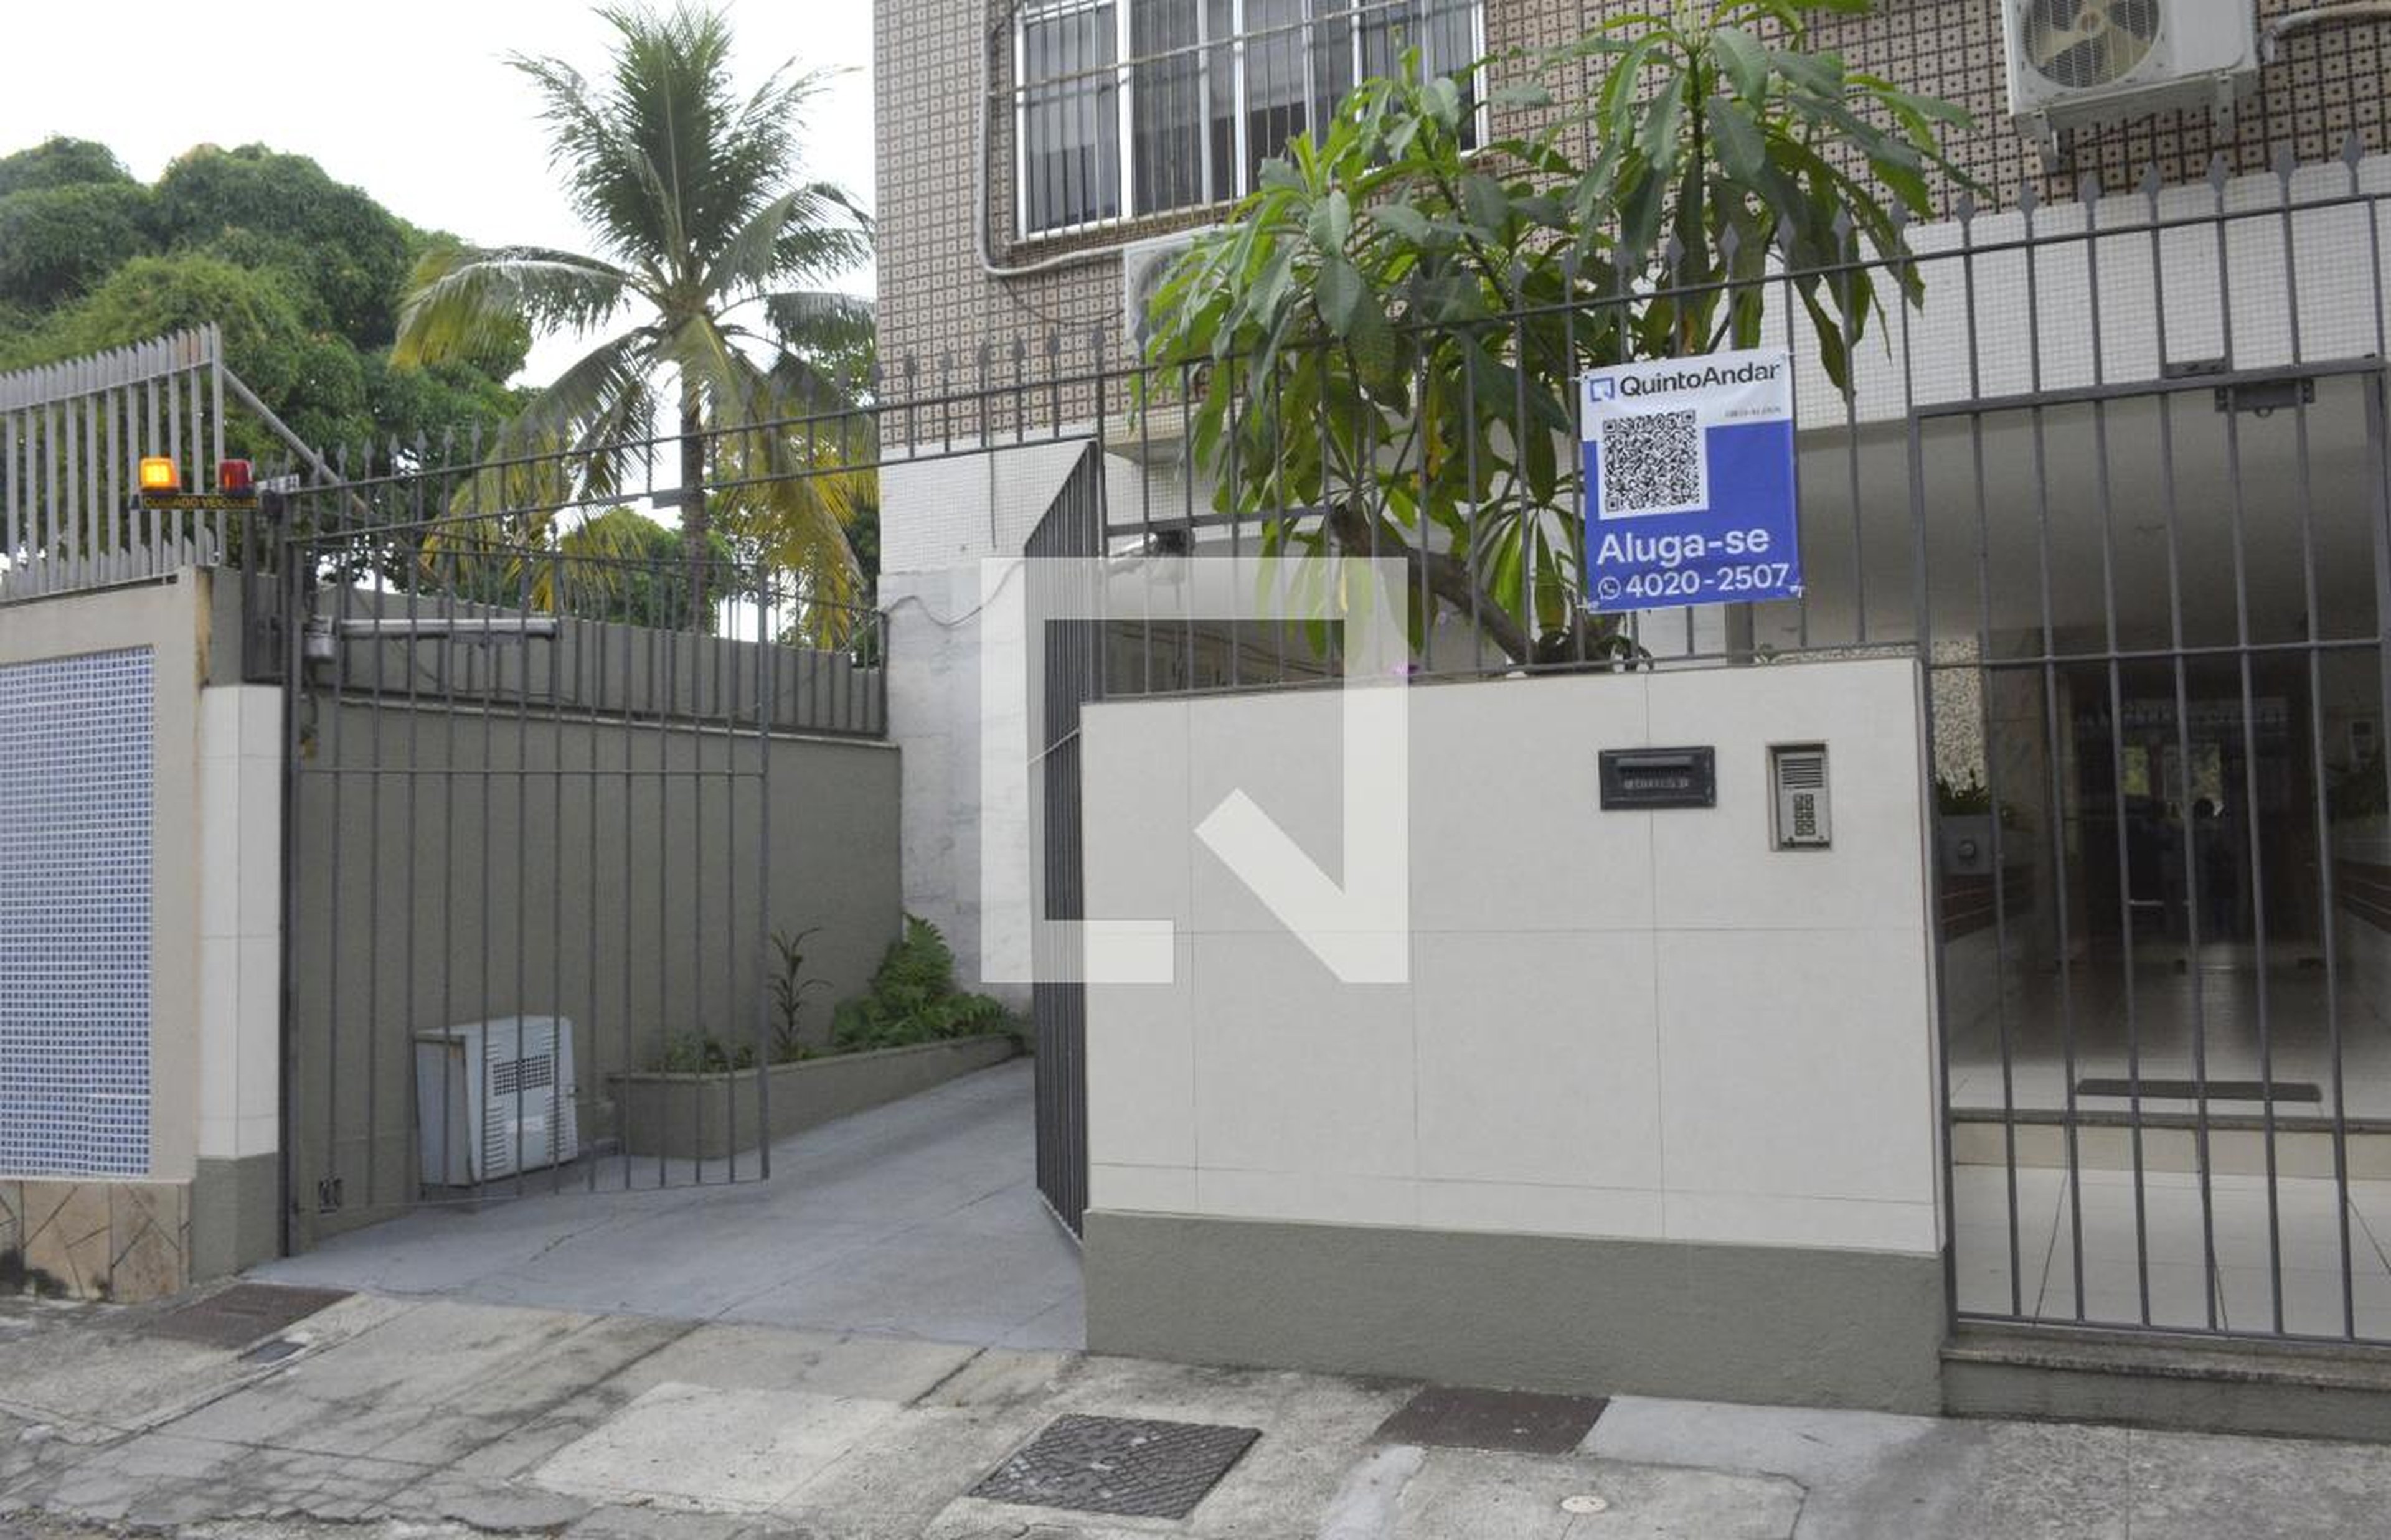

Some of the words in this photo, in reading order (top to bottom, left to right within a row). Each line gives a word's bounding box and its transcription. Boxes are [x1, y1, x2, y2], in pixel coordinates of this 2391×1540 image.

[1620, 362, 1781, 397] QuintoAndar
[1597, 529, 1770, 568] Aluga-se
[1626, 563, 1790, 598] 4020-2507
